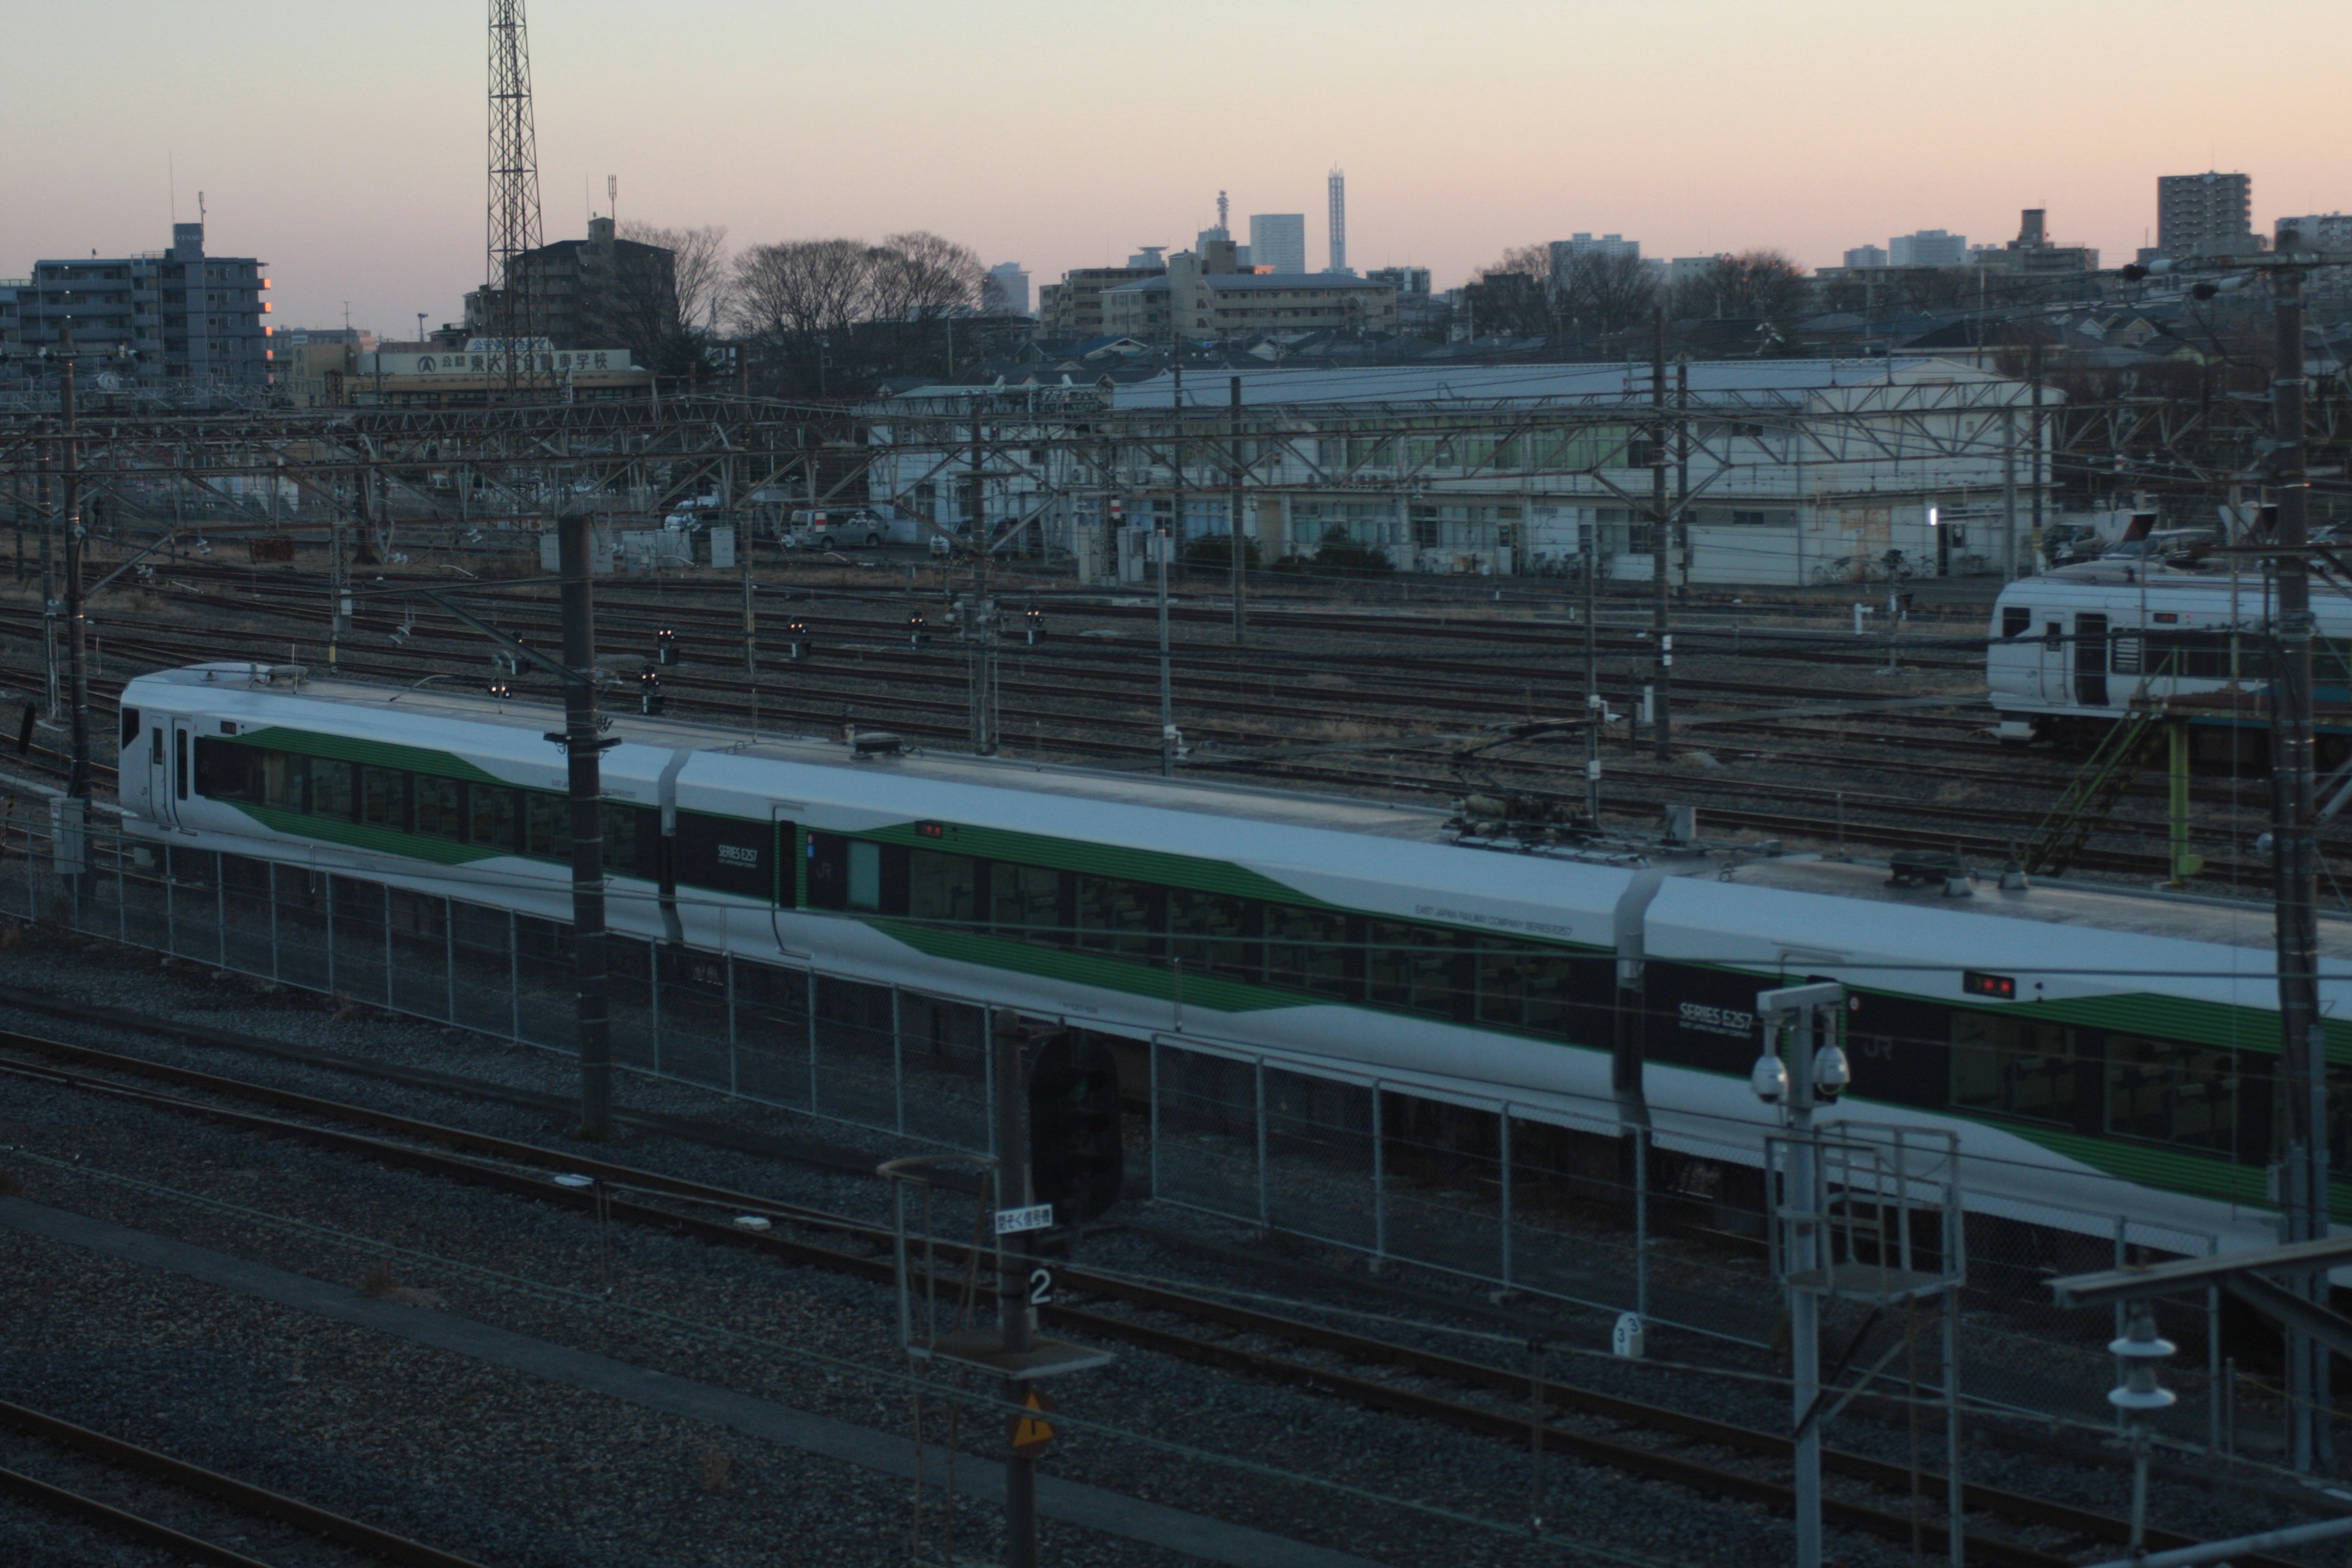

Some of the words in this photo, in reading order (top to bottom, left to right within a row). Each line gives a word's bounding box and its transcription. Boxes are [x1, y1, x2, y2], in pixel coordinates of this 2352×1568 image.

[718, 845, 741, 860] SERIES
[741, 848, 758, 862] E257
[816, 862, 831, 881] JR
[1415, 905, 1433, 914] EAST
[1488, 916, 1523, 929] COMPANY
[1679, 1003, 1721, 1025] SERIES
[1722, 1009, 1752, 1030] E257
[1863, 1036, 1892, 1060] JR
[998, 1208, 1050, 1231] 閉そく信号機
[1030, 1268, 1052, 1305] 2
[1618, 1328, 1626, 1343] 3
[1627, 1318, 1638, 1332] 3
